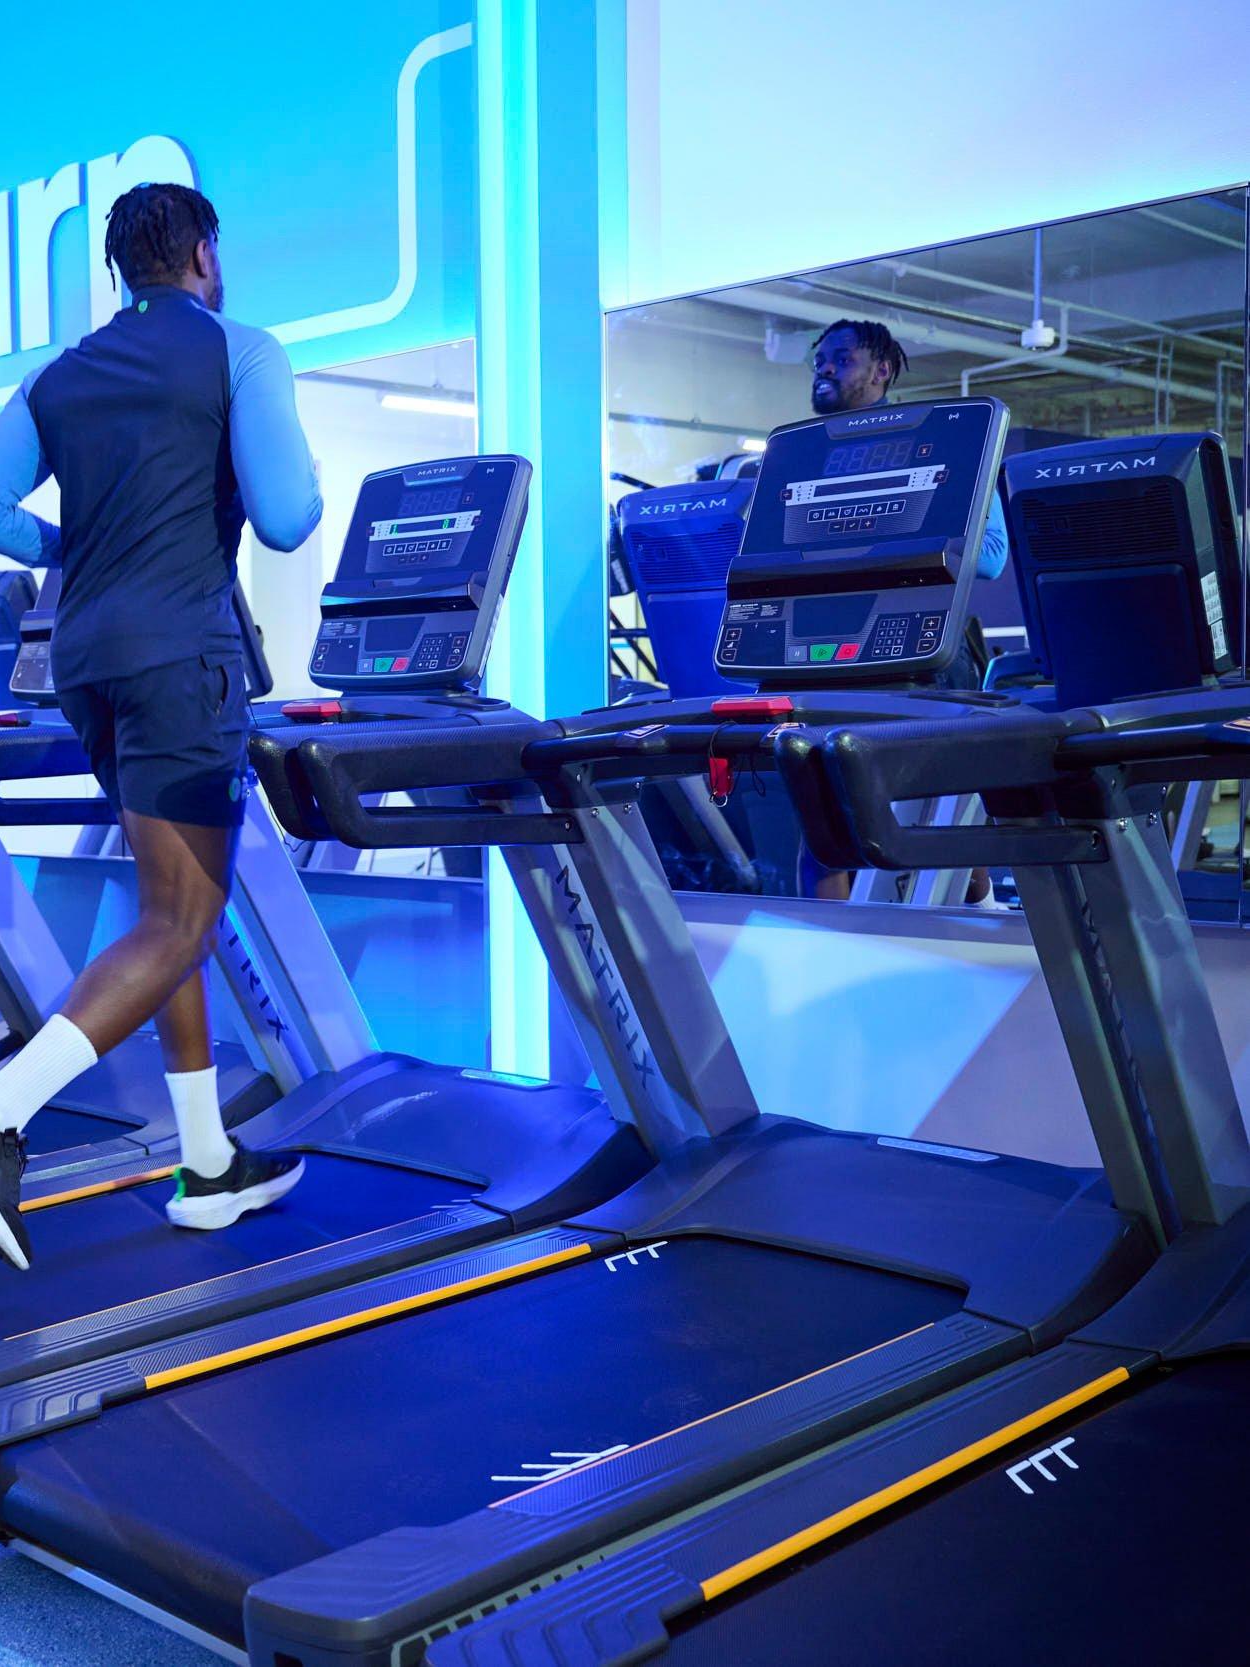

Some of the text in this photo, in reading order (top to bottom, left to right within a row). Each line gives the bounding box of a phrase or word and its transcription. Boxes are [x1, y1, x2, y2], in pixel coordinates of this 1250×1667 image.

[848, 413, 905, 427] MATRIX
[417, 466, 457, 477] MATRIX
[555, 865, 655, 1091] MATRIX
